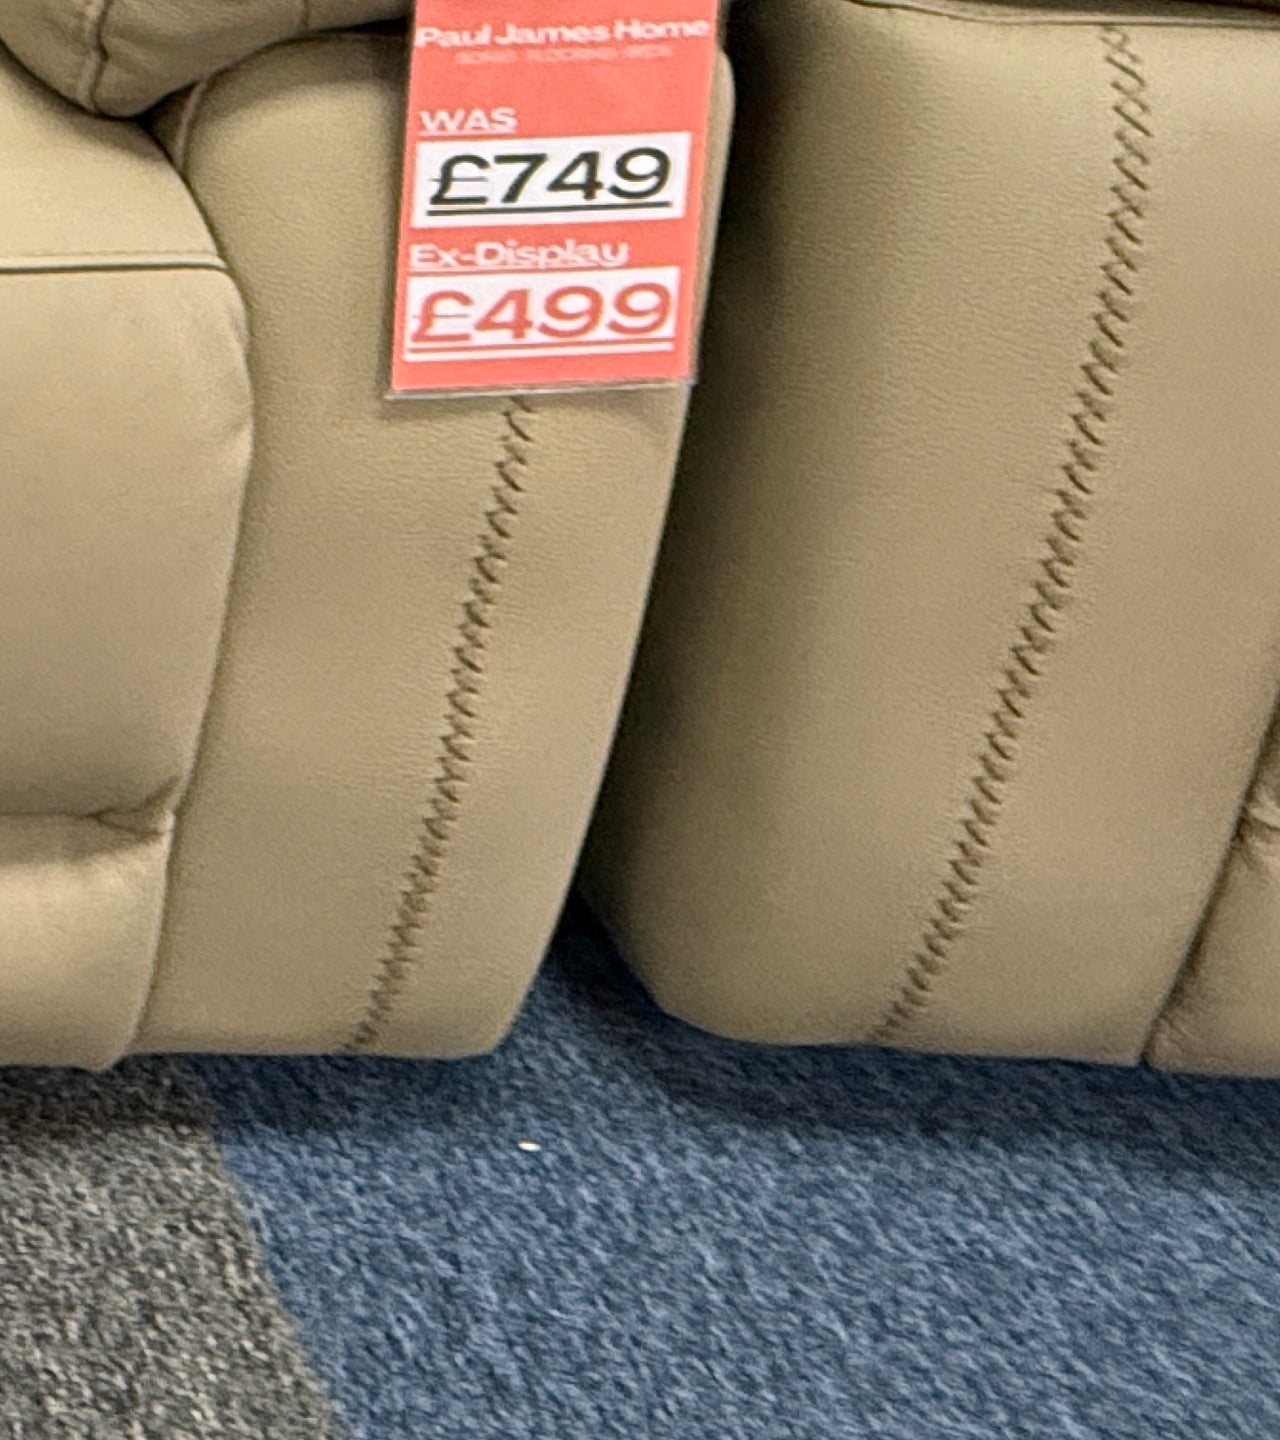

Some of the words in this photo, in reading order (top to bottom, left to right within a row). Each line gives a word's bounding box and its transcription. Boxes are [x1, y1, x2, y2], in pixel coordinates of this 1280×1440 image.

[414, 24, 492, 48] Paul
[493, 22, 612, 45] James
[613, 17, 710, 41] Home
[418, 107, 518, 133] WAS
[430, 146, 672, 206] £749
[408, 238, 630, 270] Ex-Display
[410, 282, 673, 344] £499
